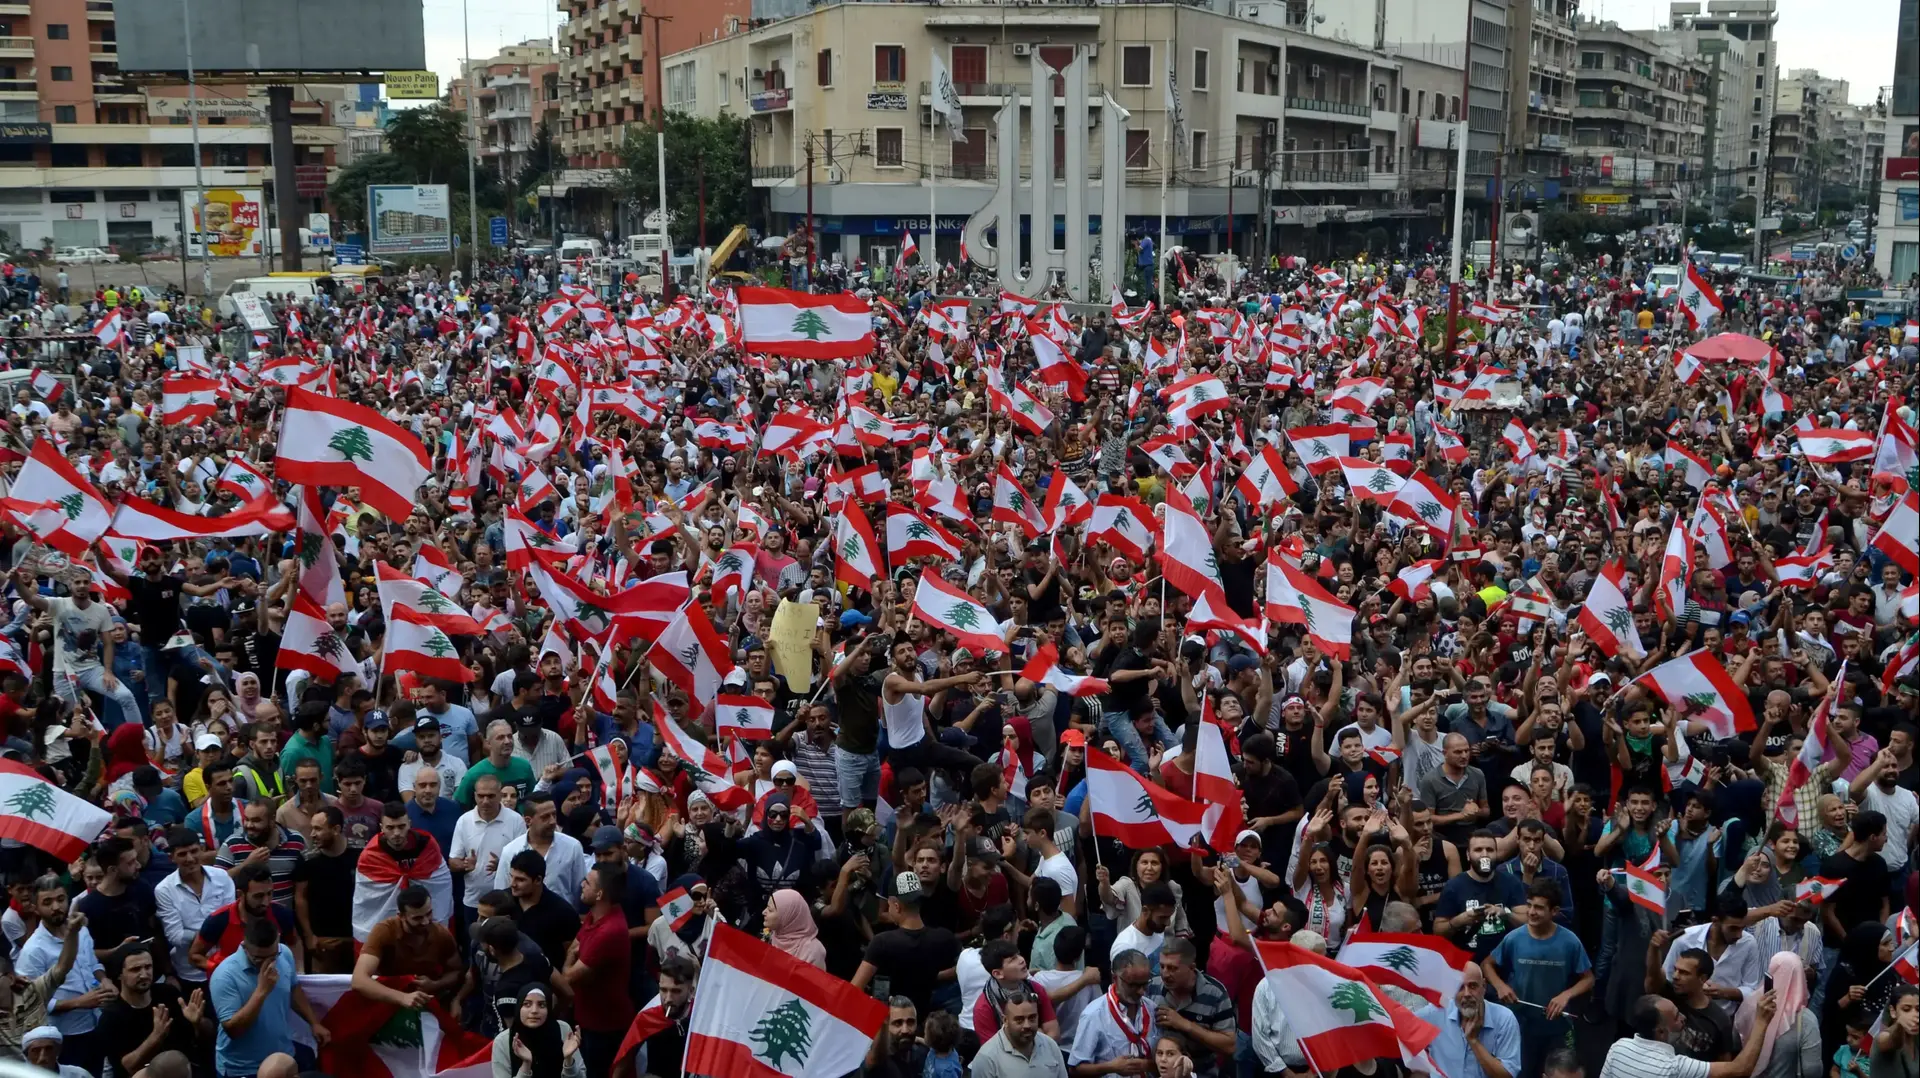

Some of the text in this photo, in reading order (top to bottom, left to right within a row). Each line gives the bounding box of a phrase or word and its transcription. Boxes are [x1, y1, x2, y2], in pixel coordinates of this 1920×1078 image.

[386, 73, 435, 83] Nouvo Pano
[176, 108, 260, 118] Makzoumi Foundation
[893, 219, 918, 230] JTB
[1275, 732, 1287, 757] TEAM
[1765, 733, 1792, 747] BOS
